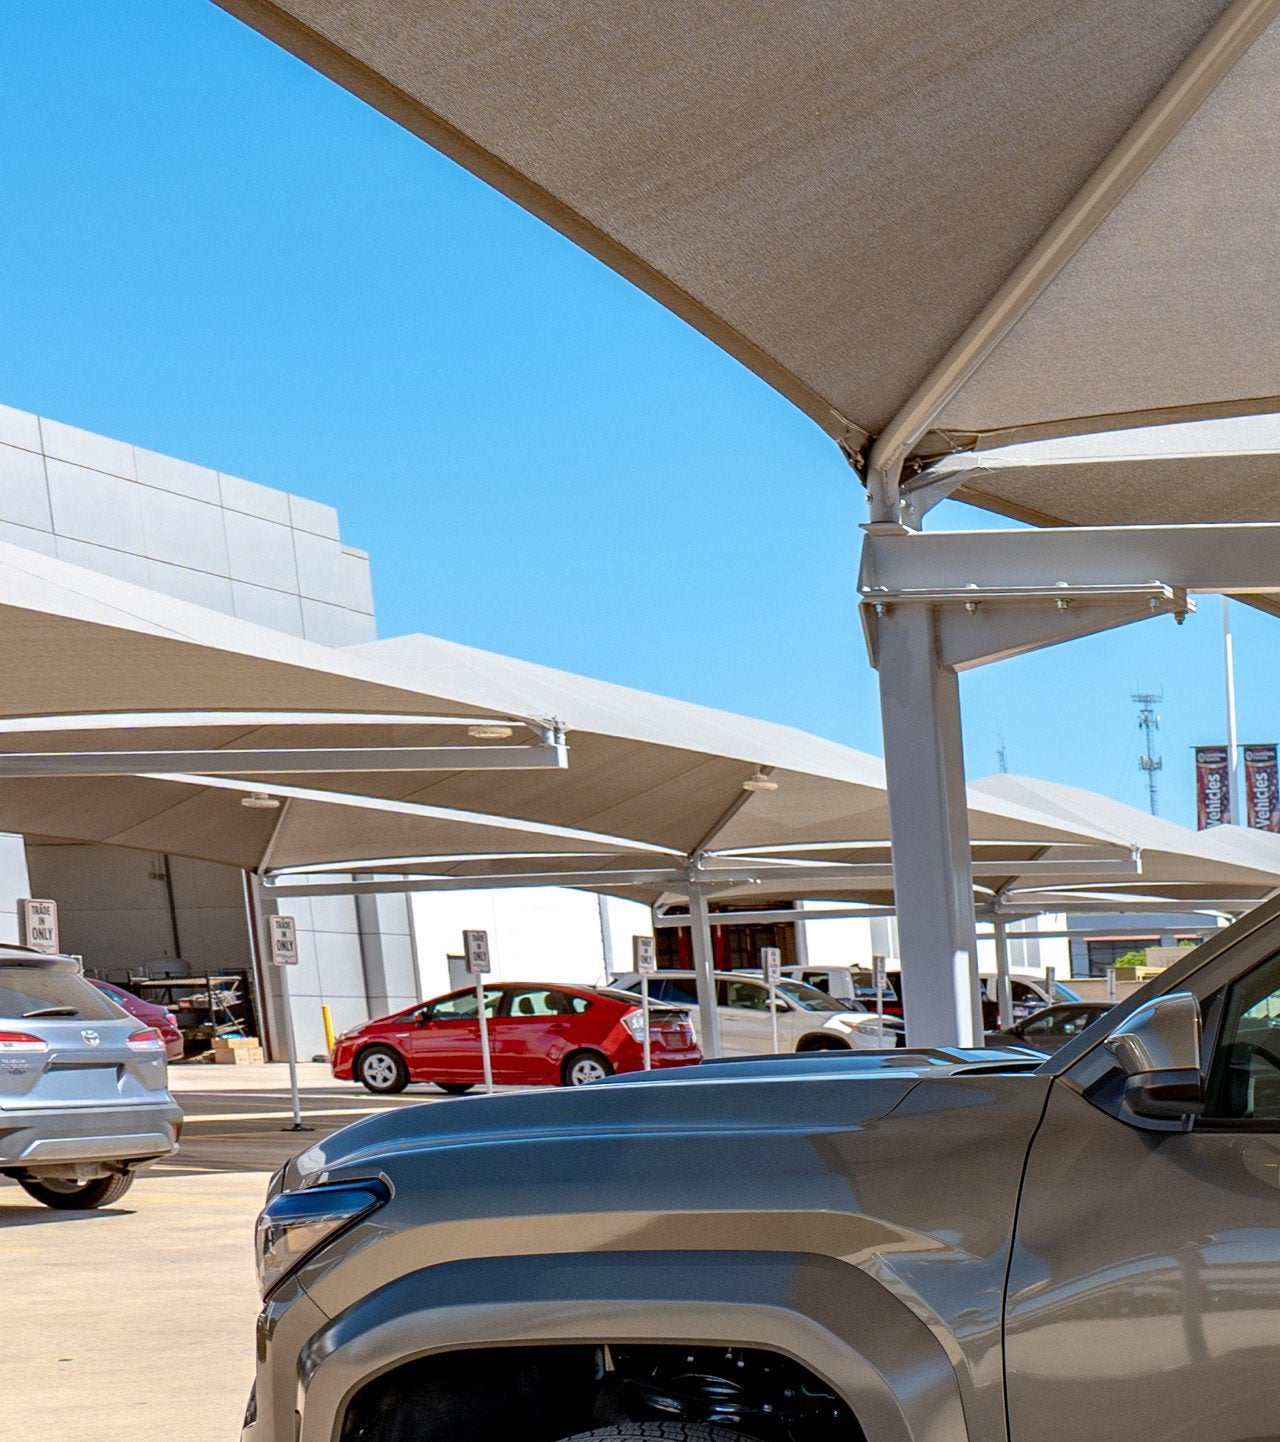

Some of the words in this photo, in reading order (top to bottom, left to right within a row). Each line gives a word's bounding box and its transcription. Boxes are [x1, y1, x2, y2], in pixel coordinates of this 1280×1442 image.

[1205, 773, 1221, 829] Vehicles
[1253, 772, 1271, 828] Vehicles
[31, 904, 51, 915] TRADE
[38, 916, 46, 926] IN
[275, 920, 291, 930] TRADE
[31, 927, 53, 940] ONLY
[281, 930, 287, 938] IN
[276, 939, 294, 951] ONLY
